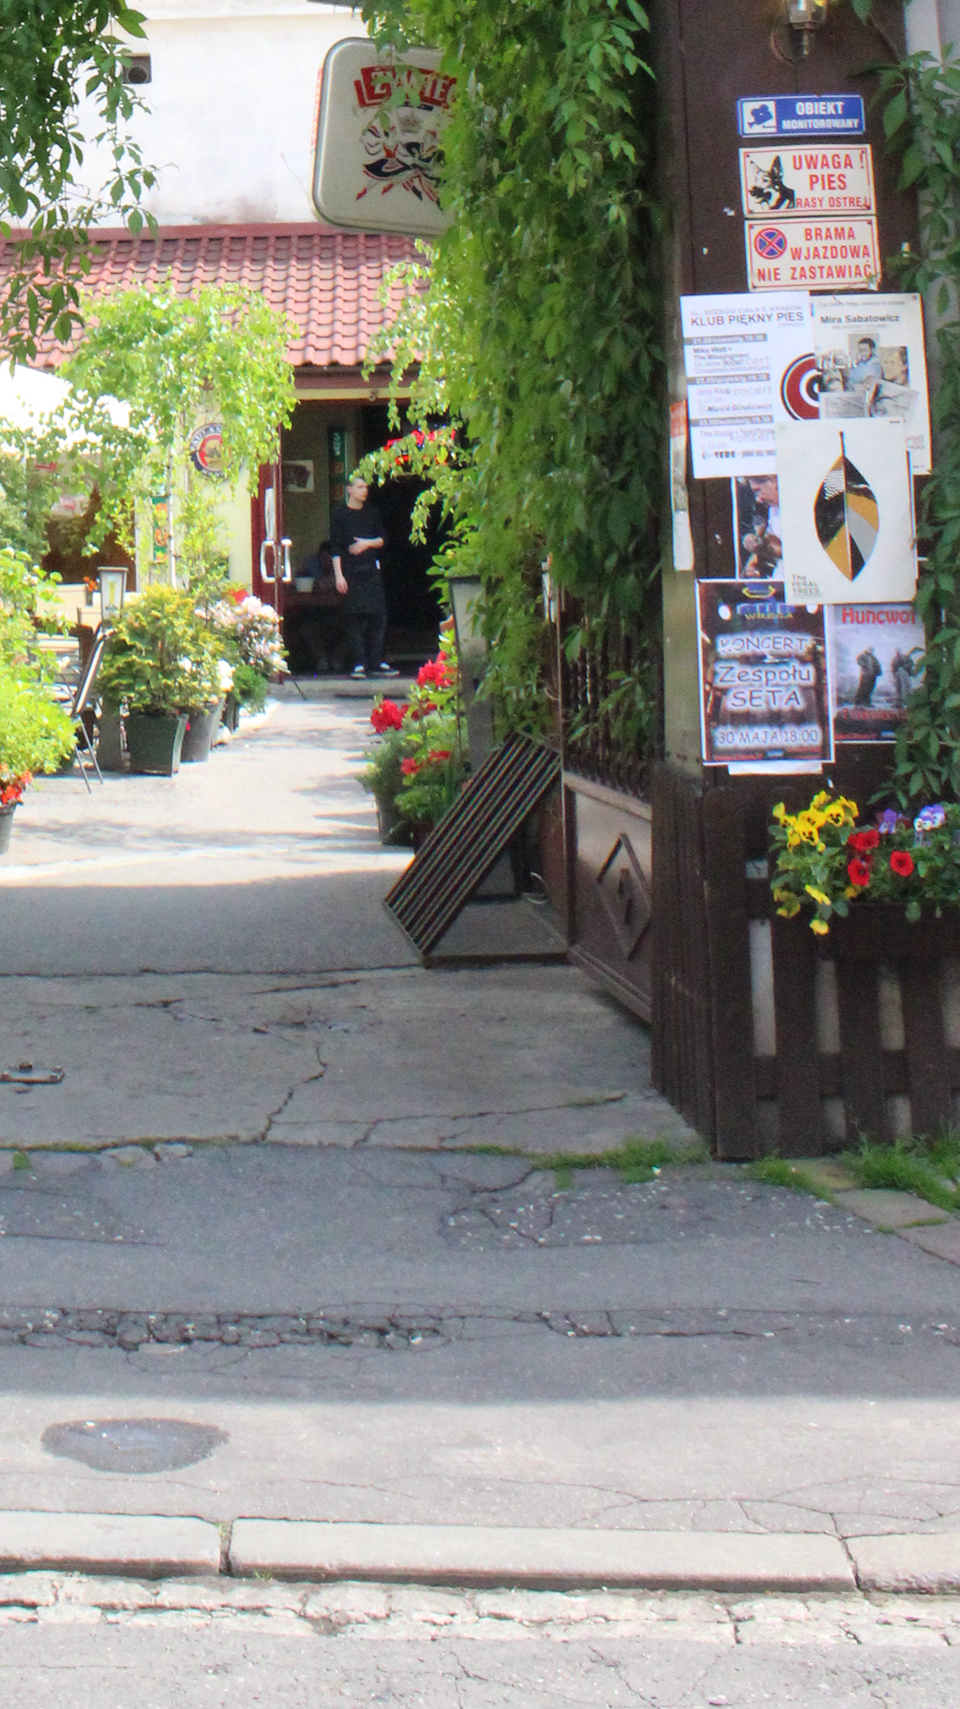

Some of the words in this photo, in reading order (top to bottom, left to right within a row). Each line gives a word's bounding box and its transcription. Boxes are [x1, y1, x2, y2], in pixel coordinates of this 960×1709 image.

[795, 101, 844, 116] OBIEKT
[782, 118, 859, 130] MONITOROWANY
[792, 153, 853, 171] UWAGA
[809, 173, 847, 191] PIES
[796, 197, 824, 208] RASY
[828, 196, 871, 209] OSTREJ
[804, 226, 855, 242] BRAMA
[790, 245, 870, 260] WJAZDOWA
[757, 268, 781, 282] NIE
[790, 261, 872, 280] ZASTAWIAĆ
[690, 315, 725, 326] KLUB
[728, 313, 773, 326] PIĘKNY
[776, 312, 804, 322] PIES
[820, 316, 842, 324] Mira
[845, 314, 900, 324] Sabatowicz
[720, 636, 807, 653] KONCERT
[718, 664, 811, 687] Zespołu
[731, 689, 801, 708] SETA
[718, 730, 734, 745] 30
[739, 730, 780, 744] MAJA
[783, 728, 818, 743] 18:00
